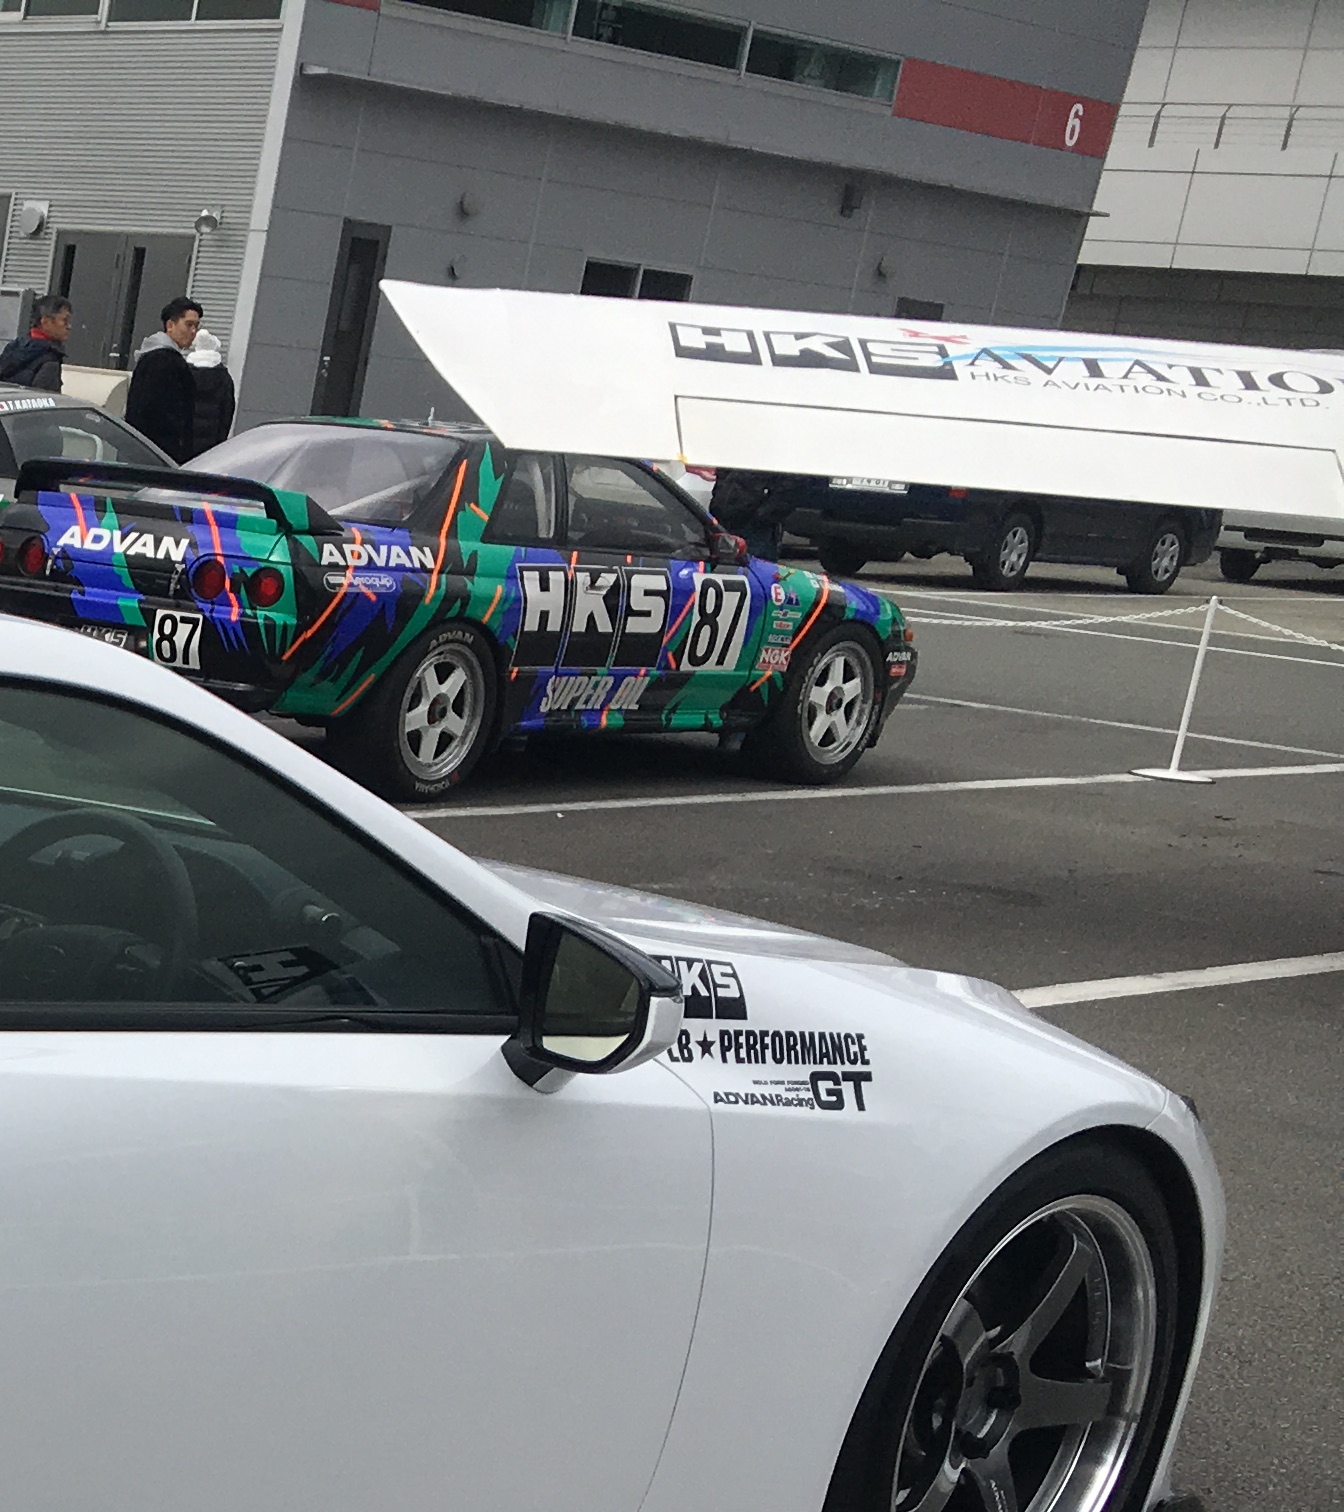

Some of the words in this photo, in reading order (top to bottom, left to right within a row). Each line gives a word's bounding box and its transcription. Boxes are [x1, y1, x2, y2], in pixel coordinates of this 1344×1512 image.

[1064, 103, 1084, 148] 6
[672, 323, 953, 374] HKS
[966, 346, 1344, 396] AVIATIO
[970, 371, 1031, 386] HKS
[1042, 380, 1187, 399] AVIATION
[57, 525, 190, 562] ADVAN
[320, 543, 436, 569] ADVAN
[516, 567, 669, 638] HKS
[687, 577, 748, 668] 87
[155, 613, 201, 665] 87
[428, 630, 474, 650] ADVAN
[760, 648, 790, 665] NGK
[540, 675, 615, 713] SUPER
[609, 675, 651, 711] OIL
[657, 957, 744, 1005] KS
[719, 1029, 871, 1066] PERFORMANCE
[809, 1070, 873, 1112] GT
